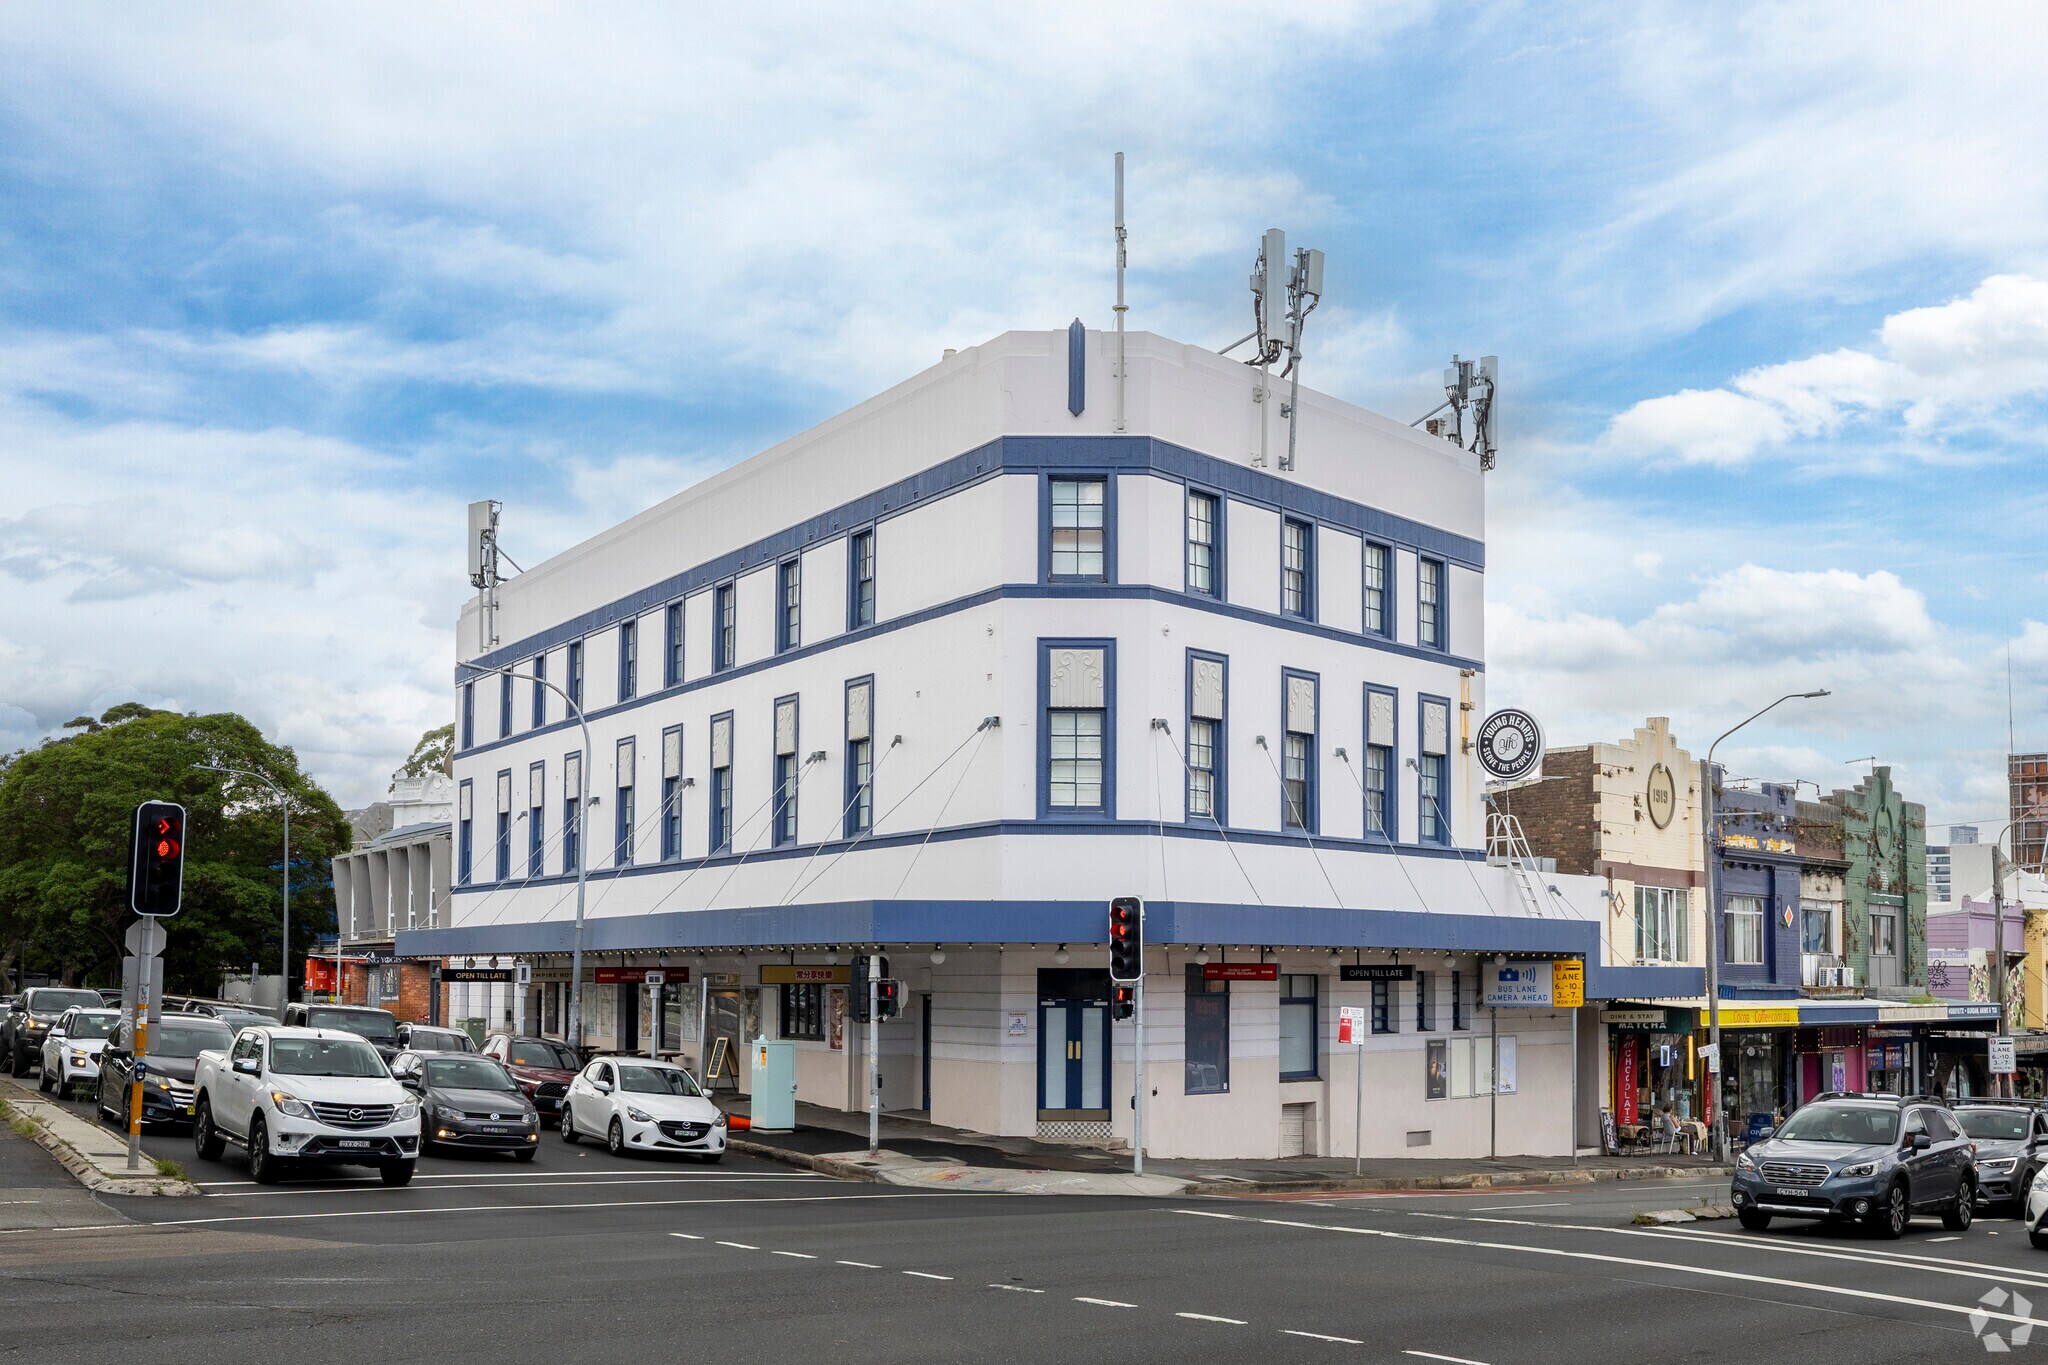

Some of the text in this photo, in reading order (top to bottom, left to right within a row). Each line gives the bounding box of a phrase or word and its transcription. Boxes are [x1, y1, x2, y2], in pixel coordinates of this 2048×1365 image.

[1482, 715, 1535, 742] YOUNG HENRYS
[1482, 746, 1532, 772] SERVE THE PEOPLE
[1349, 969, 1404, 977] OPEN TILL LATE
[1556, 973, 1580, 981] LANE
[1497, 985, 1537, 993] BUS LANE
[1487, 994, 1548, 1002] CAMERA AHEAD
[1733, 1010, 1750, 1023] Cocoa
